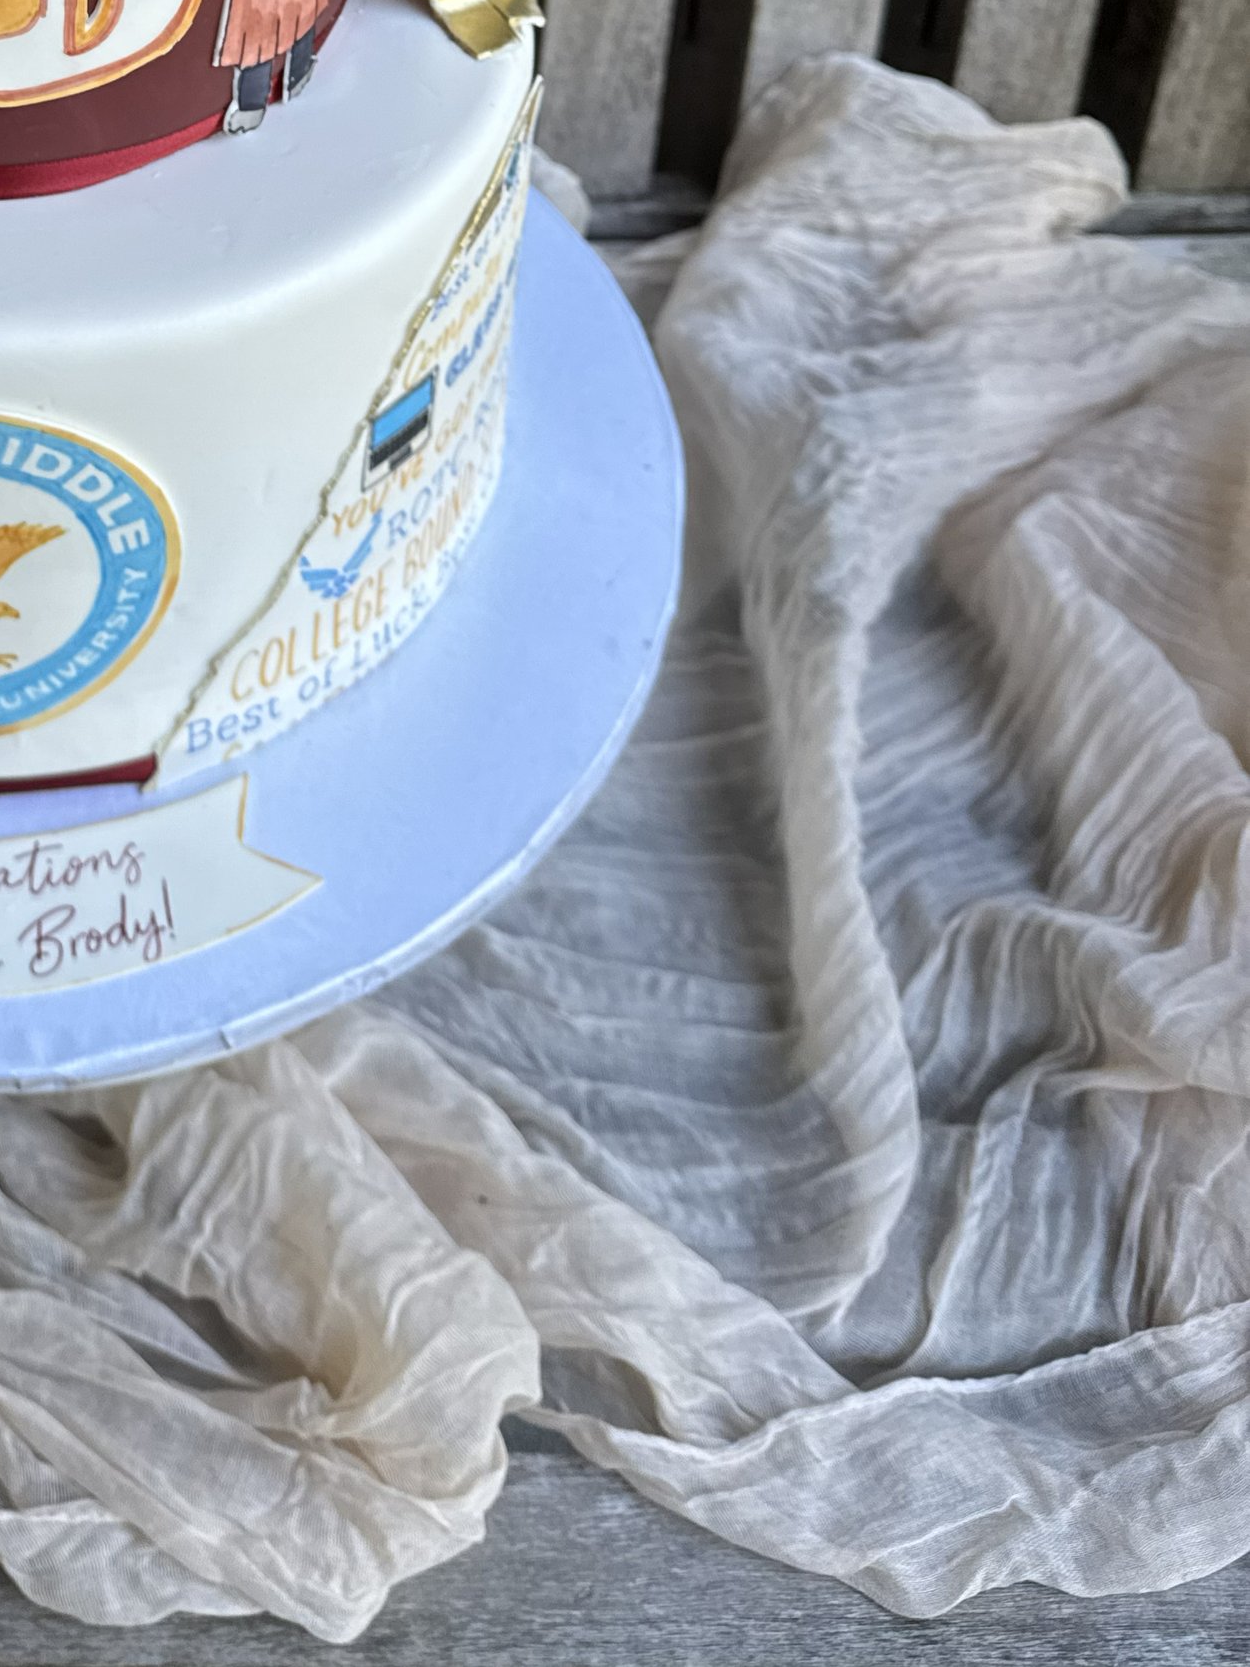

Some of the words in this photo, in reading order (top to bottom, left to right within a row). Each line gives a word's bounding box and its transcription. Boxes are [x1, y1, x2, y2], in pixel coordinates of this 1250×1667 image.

[0, 566, 148, 711] UNIVERSITY
[229, 554, 395, 703] COLLEGE
[186, 695, 282, 754] Best
[17, 877, 177, 979] Brody!
